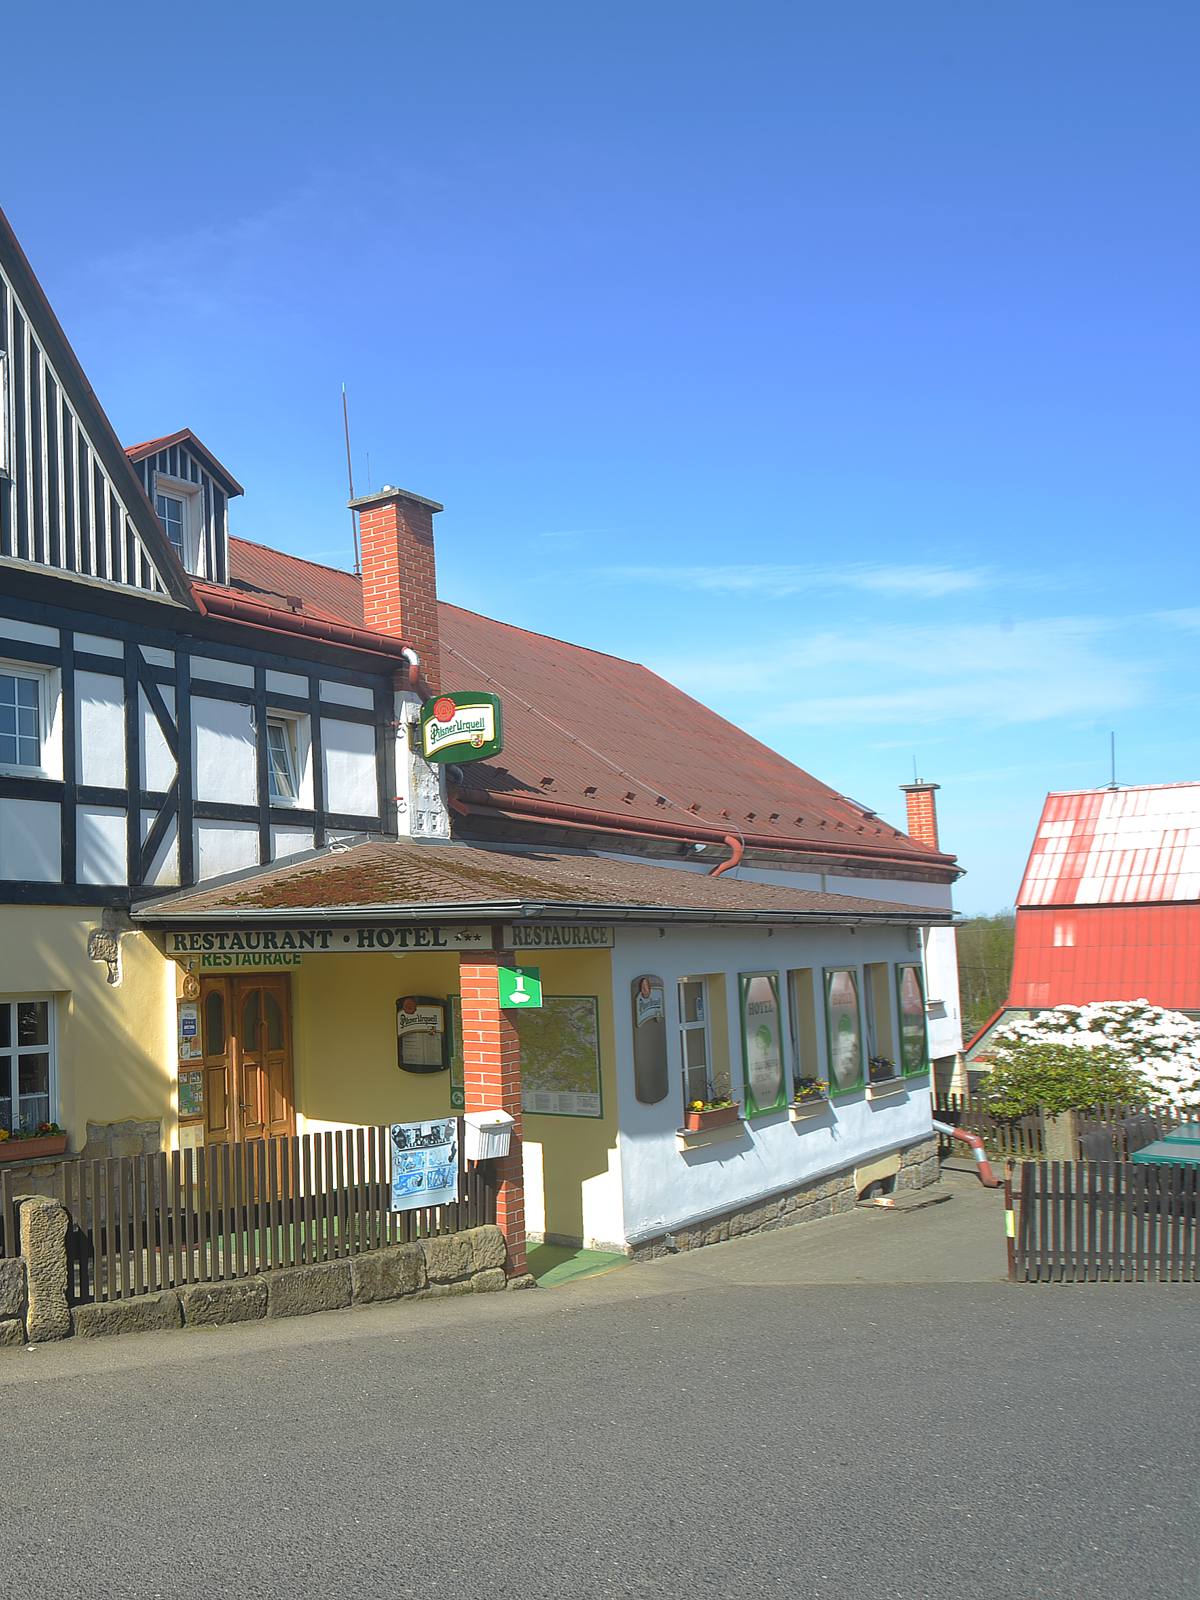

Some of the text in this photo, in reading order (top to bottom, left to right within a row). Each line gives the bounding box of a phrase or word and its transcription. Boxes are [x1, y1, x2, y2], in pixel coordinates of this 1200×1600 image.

[430, 717, 485, 745] Pilsner Urquell
[173, 926, 448, 952] RESTAURANT HOTEL
[511, 925, 609, 946] RESTAURACE
[202, 952, 301, 967] RESTAURACE
[747, 1000, 774, 1017] HOTEL
